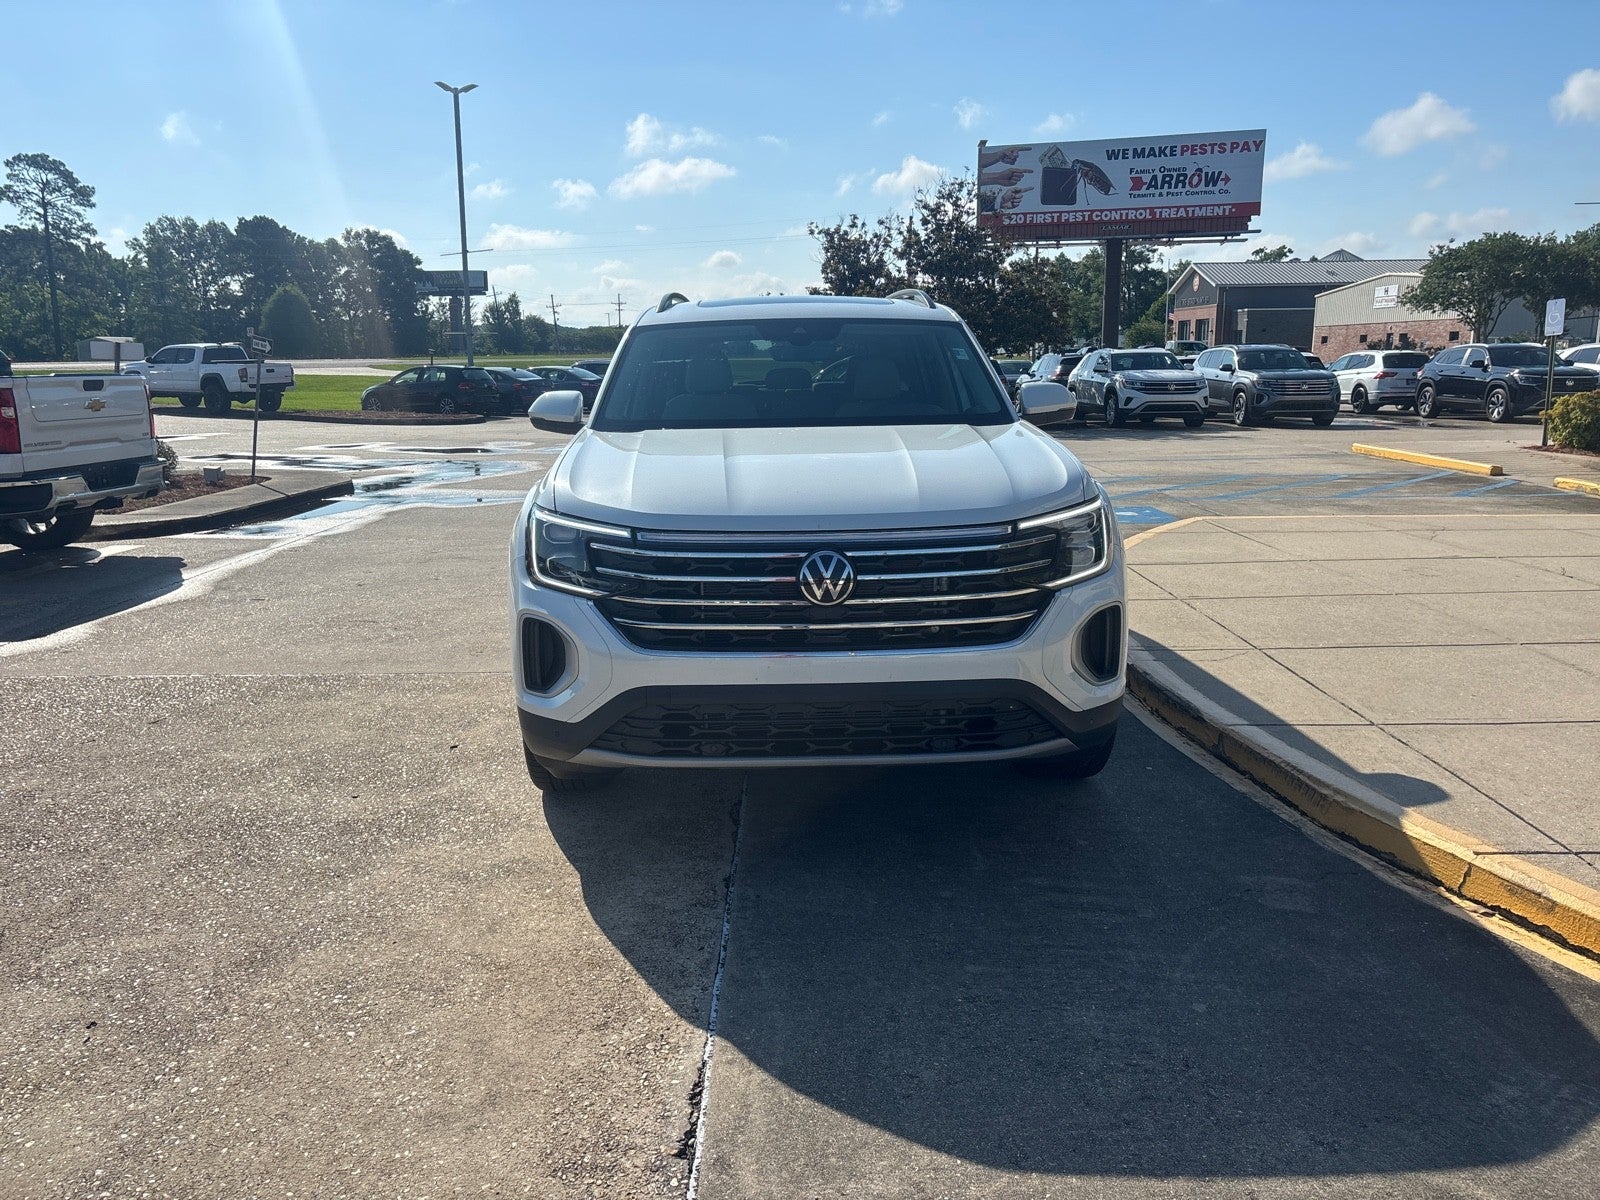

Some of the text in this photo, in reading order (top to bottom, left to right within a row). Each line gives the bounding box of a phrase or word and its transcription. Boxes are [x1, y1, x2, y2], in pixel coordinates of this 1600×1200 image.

[1106, 140, 1264, 161] WE MAKE PESTS PAY
[1145, 171, 1223, 191] ARROW
[1026, 212, 1060, 224] FIRST
[1061, 211, 1091, 222] PEST
[1092, 208, 1152, 222] CONTROL
